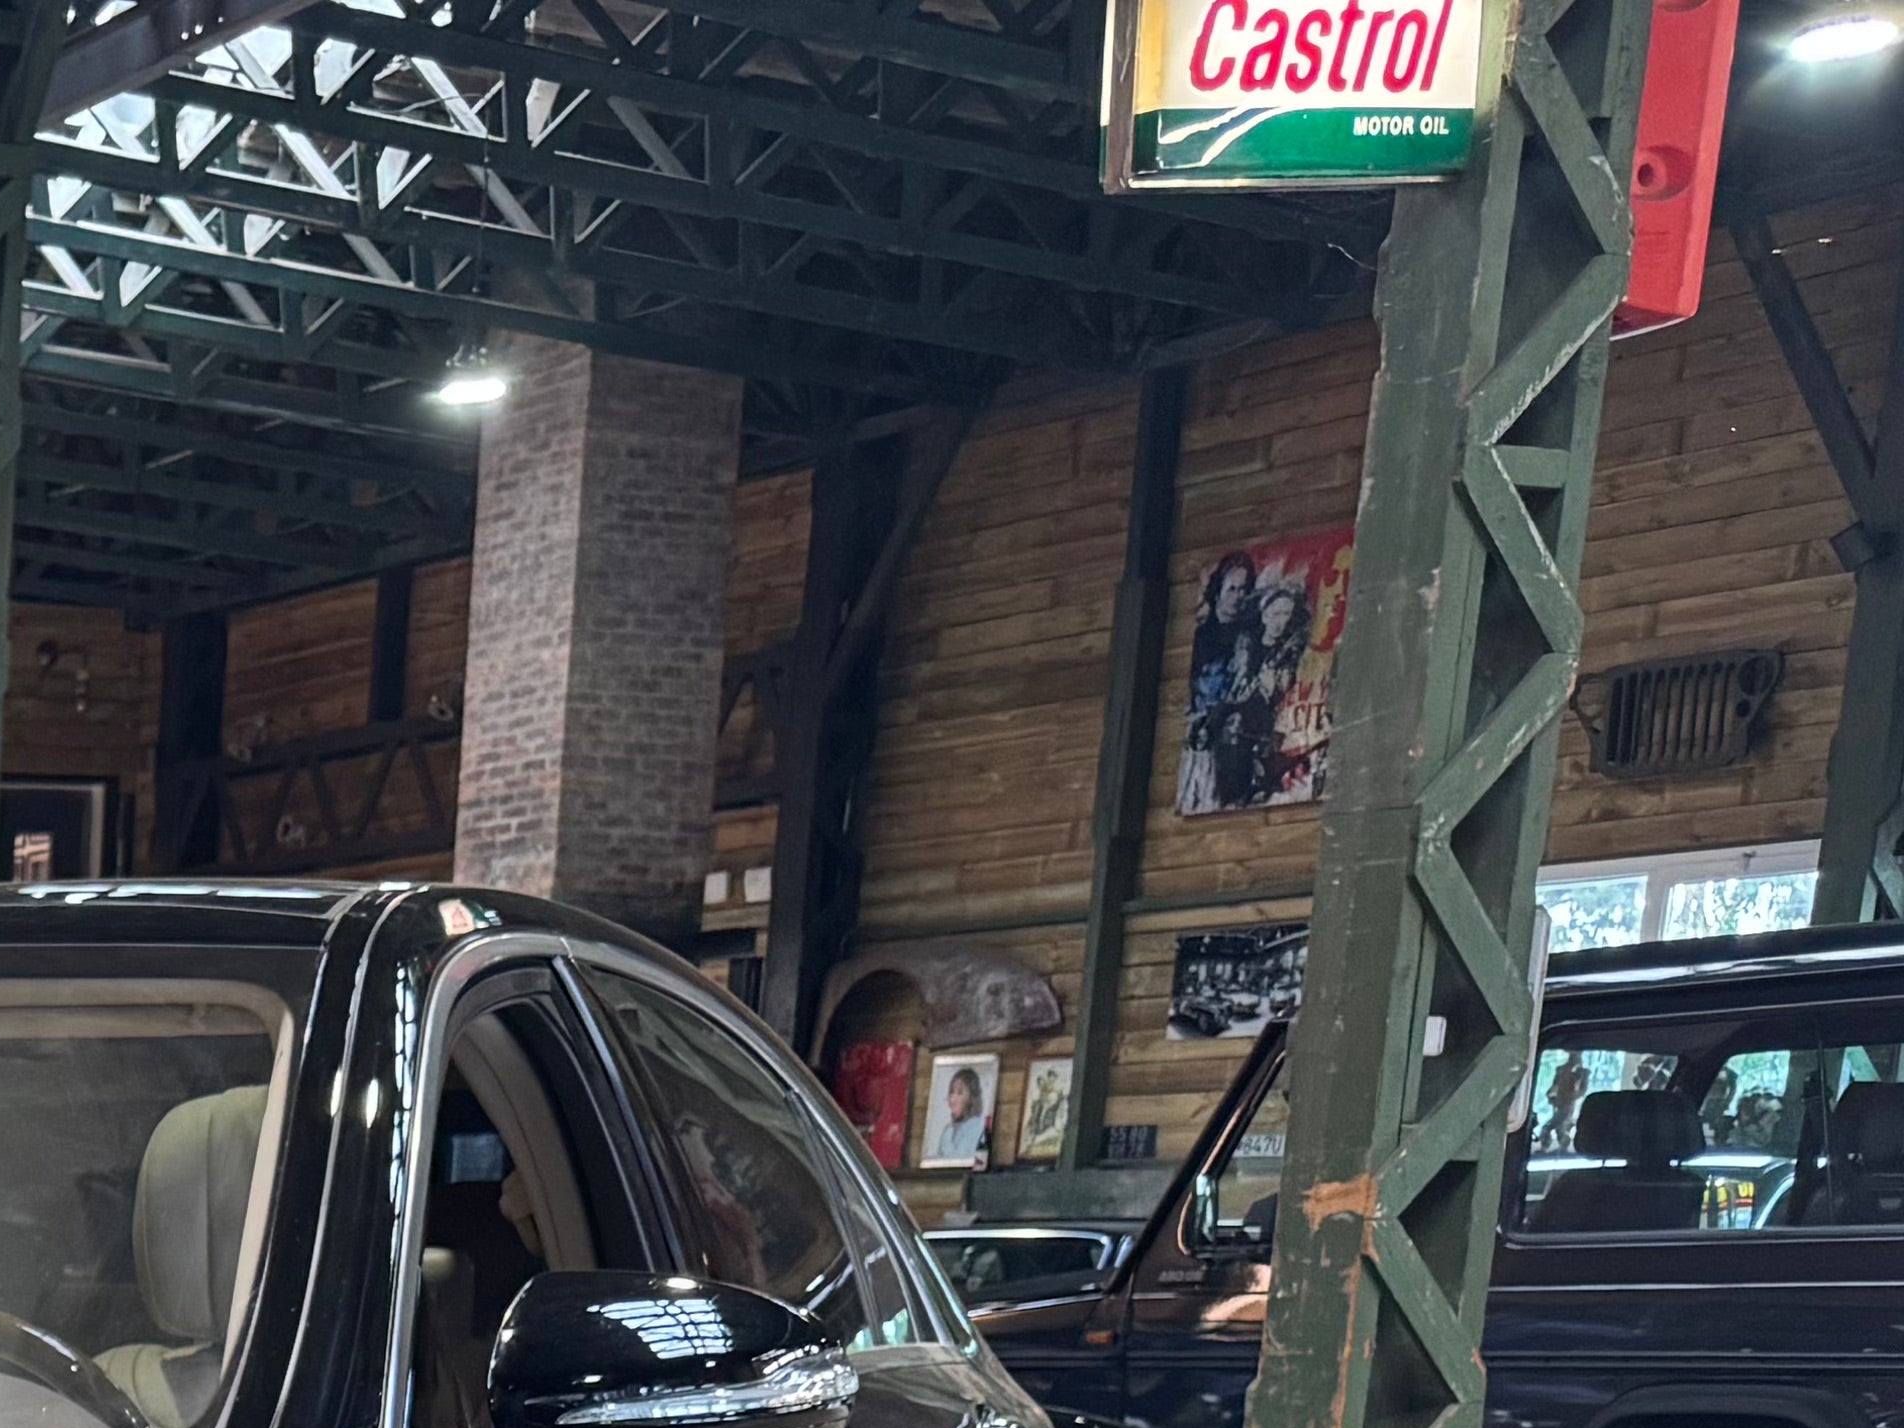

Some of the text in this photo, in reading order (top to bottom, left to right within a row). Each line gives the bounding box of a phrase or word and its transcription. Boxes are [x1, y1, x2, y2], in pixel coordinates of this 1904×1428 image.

[1189, 0, 1454, 94] Castrol
[1352, 114, 1450, 136] MOTOR OIL
